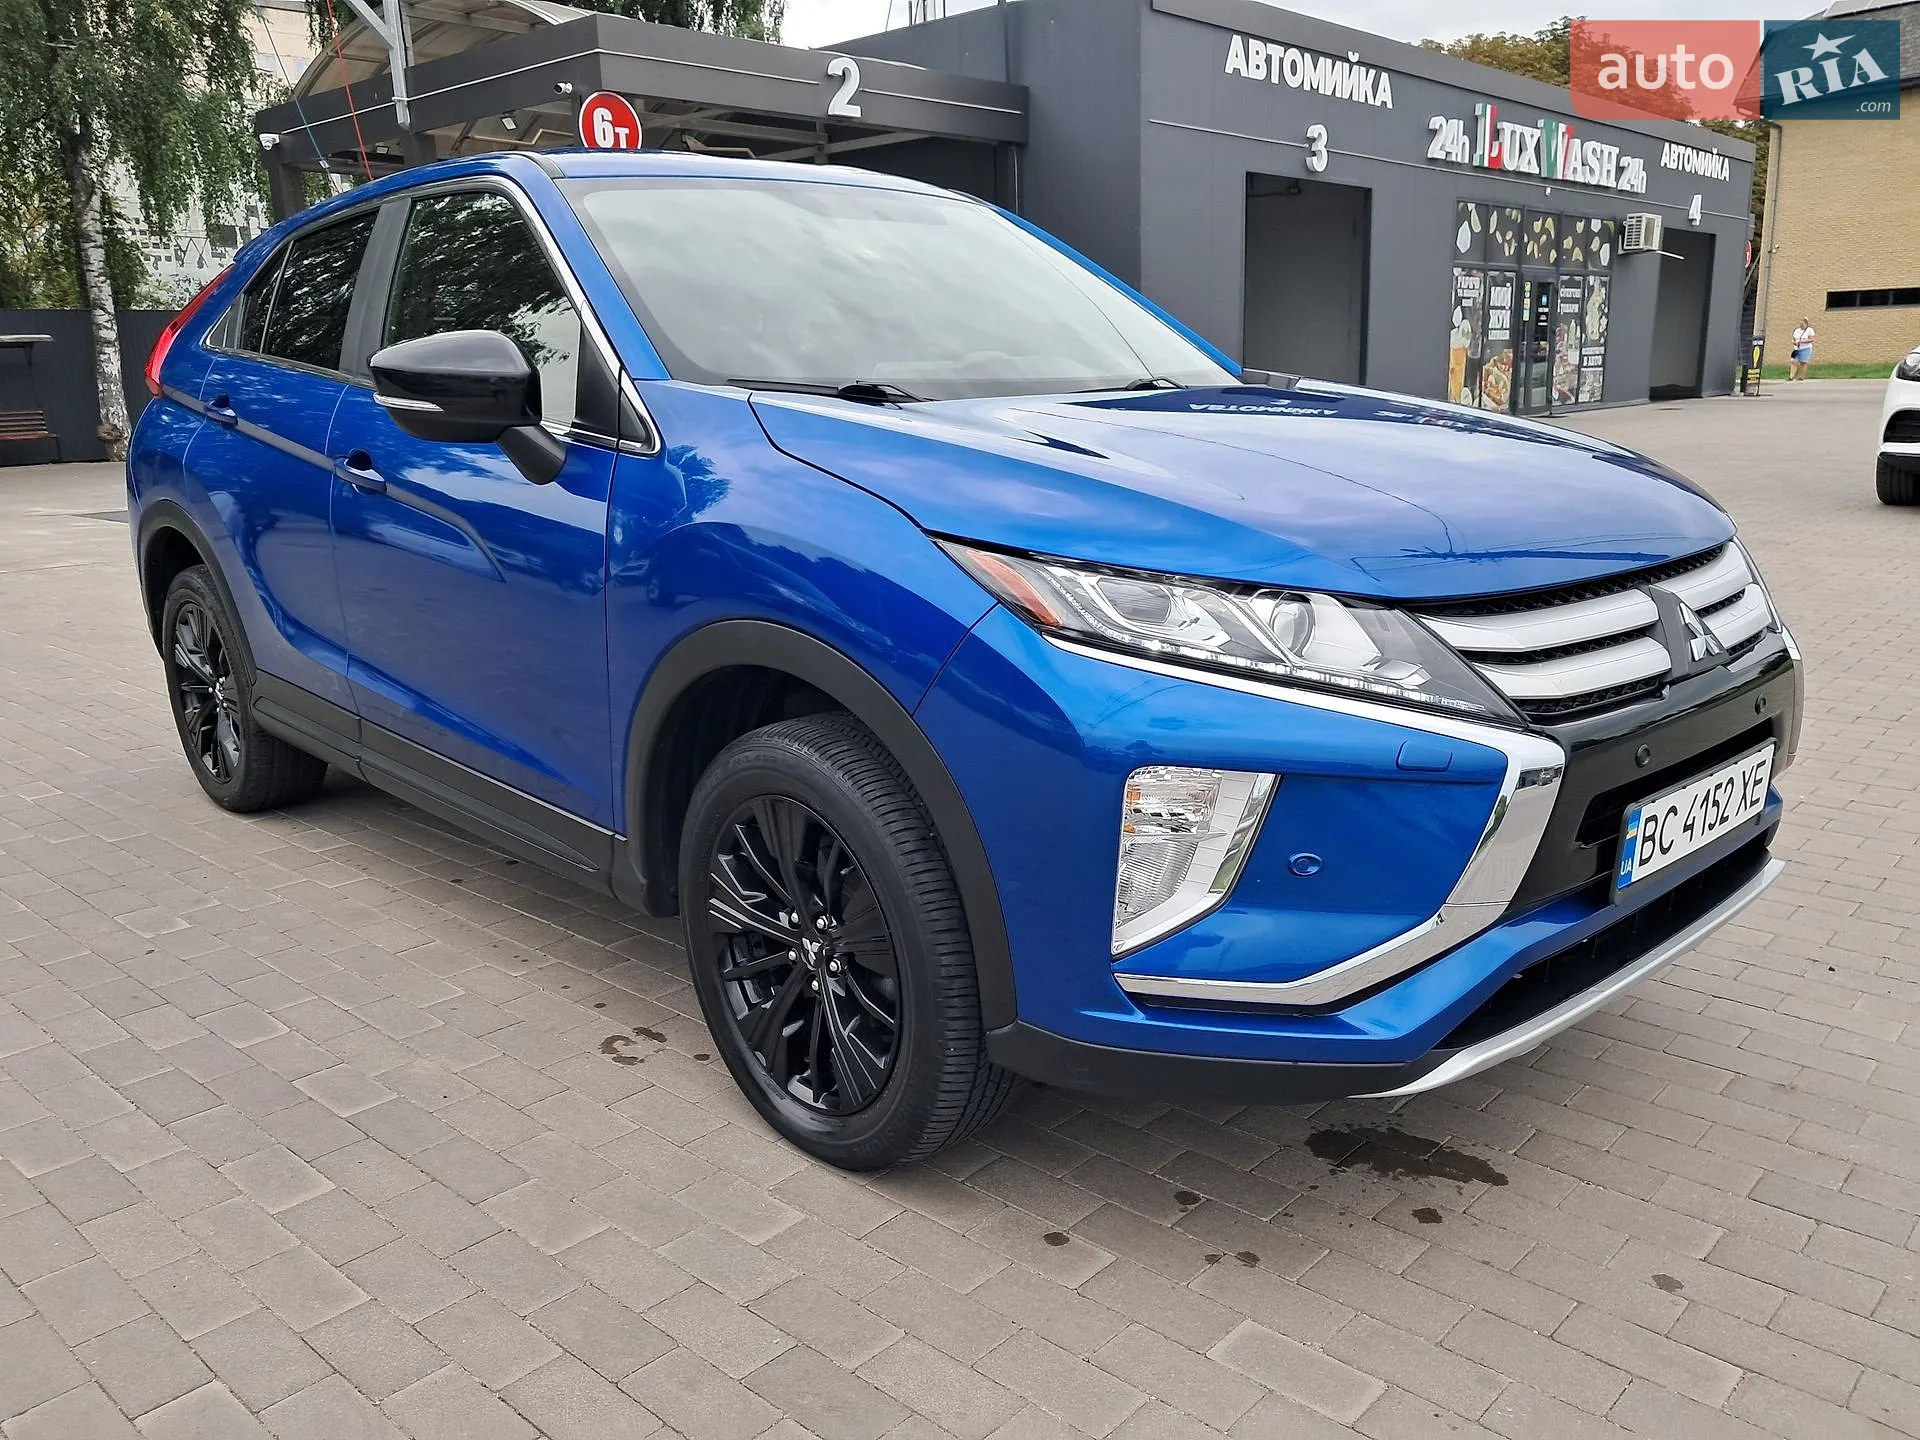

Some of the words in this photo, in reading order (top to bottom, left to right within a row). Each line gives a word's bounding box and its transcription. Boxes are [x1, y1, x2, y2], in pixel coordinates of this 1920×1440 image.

[827, 56, 862, 118] 2
[1225, 34, 1393, 110] АВТОМИЙКА
[1305, 123, 1328, 172] 3
[1426, 115, 1470, 164] 24h
[1617, 155, 1647, 194] 24h
[1660, 141, 1730, 182] АВТОМИЙКА
[1688, 194, 1702, 226] 4
[1639, 805, 1678, 867] BC
[1683, 776, 1735, 842] 4152
[1736, 759, 1766, 818] XE
[1620, 857, 1632, 876] UA
